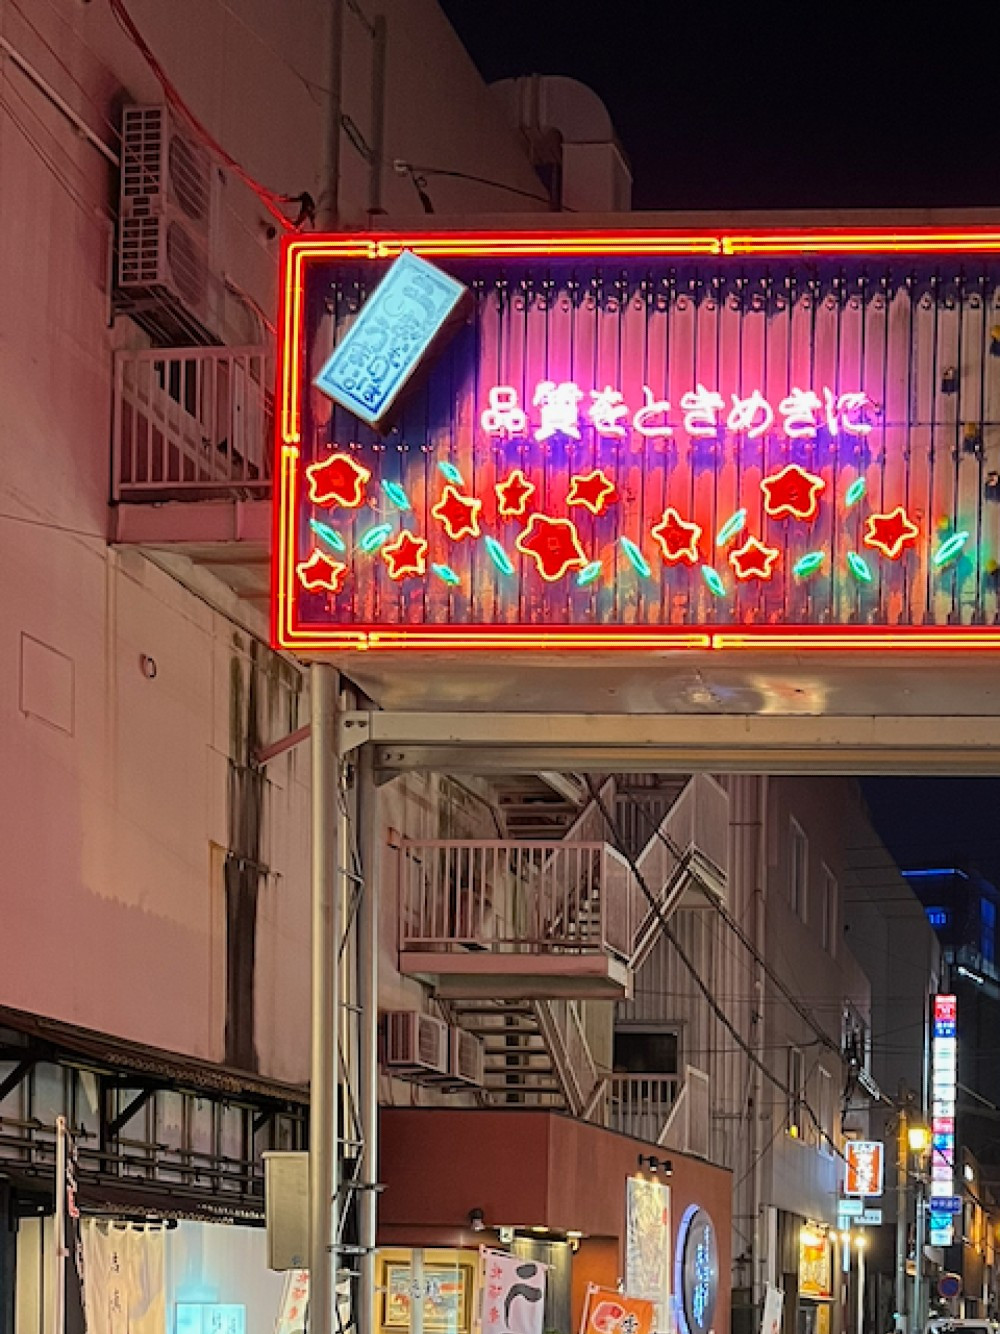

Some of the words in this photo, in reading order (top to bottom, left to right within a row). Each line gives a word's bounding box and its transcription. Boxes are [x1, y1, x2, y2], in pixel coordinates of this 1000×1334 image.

[480, 380, 872, 440] 品質をときめきに
